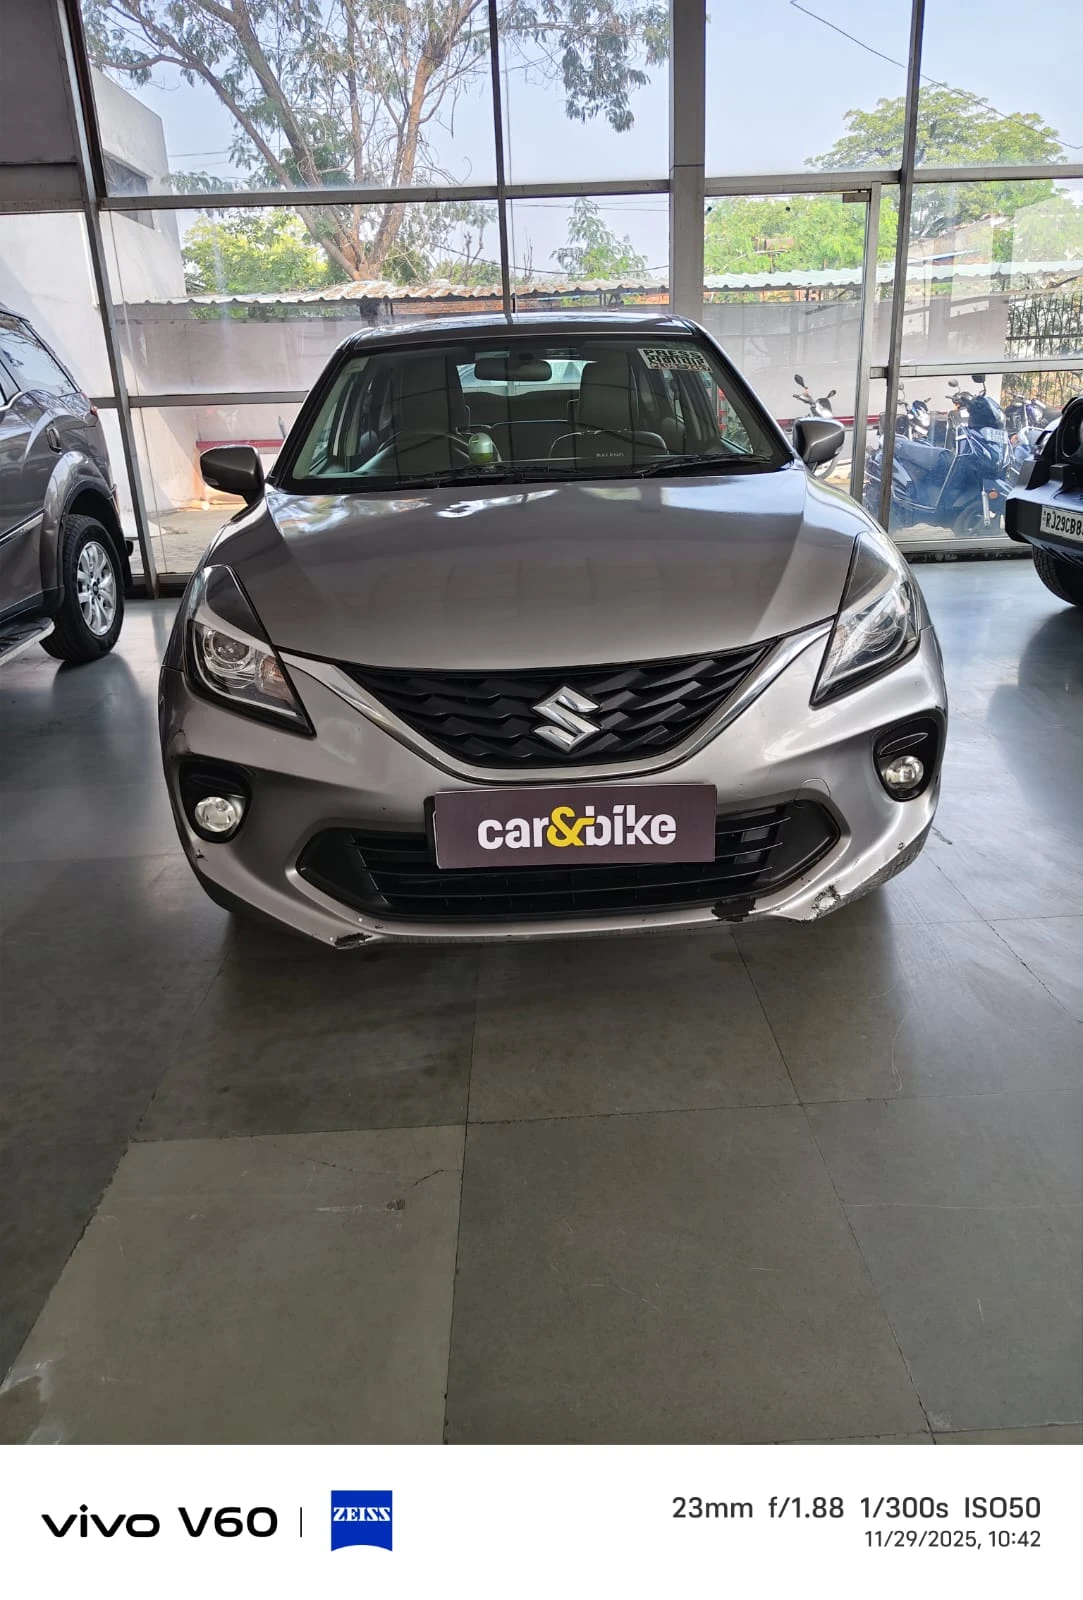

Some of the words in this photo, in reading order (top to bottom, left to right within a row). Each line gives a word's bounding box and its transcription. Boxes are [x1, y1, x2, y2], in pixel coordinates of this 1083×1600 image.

[643, 349, 701, 360] PRESS
[1046, 510, 1083, 537] RJ29CB8
[477, 804, 677, 850] car&bike
